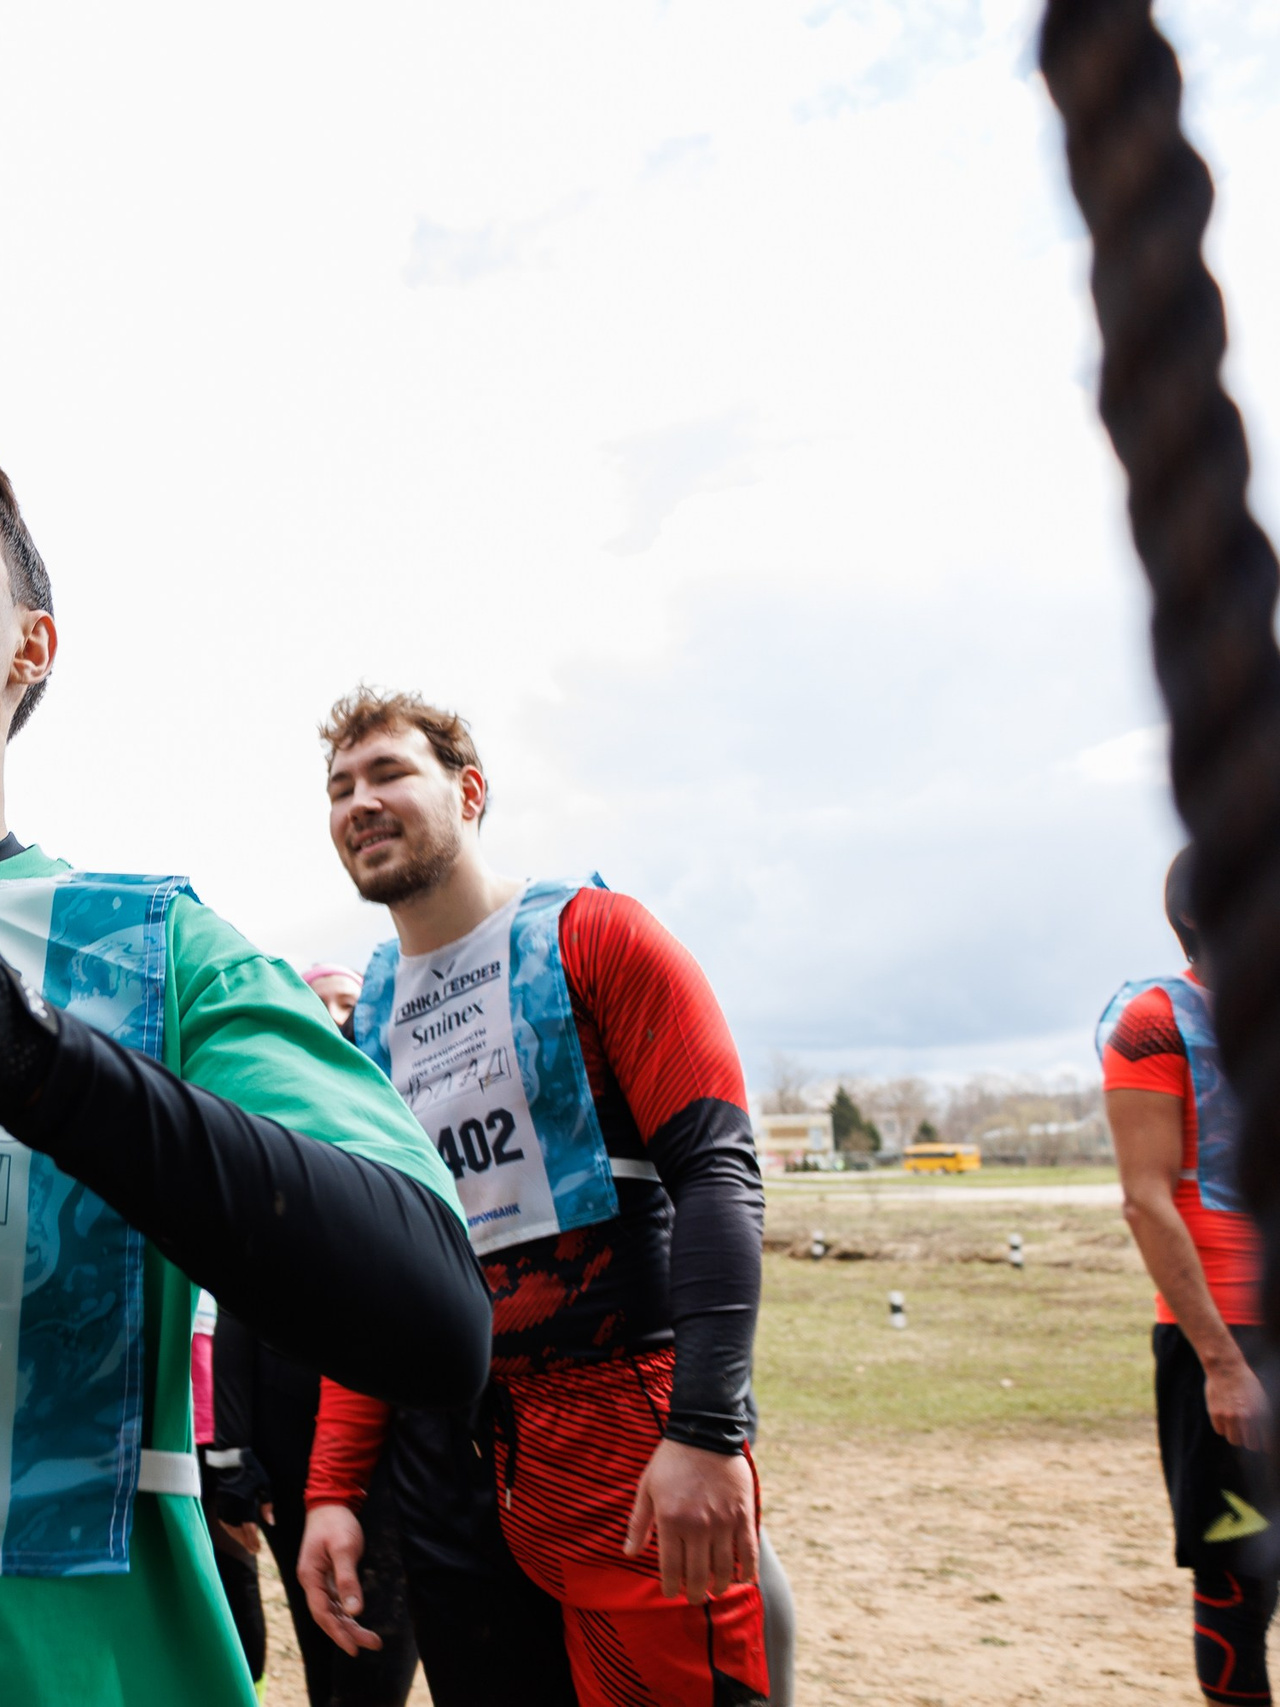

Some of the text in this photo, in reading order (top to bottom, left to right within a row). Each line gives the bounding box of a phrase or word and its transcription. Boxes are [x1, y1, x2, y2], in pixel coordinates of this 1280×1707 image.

[443, 960, 500, 998] ГЕРОЕВ
[412, 998, 484, 1049] Sminex
[437, 1107, 525, 1180] 402
